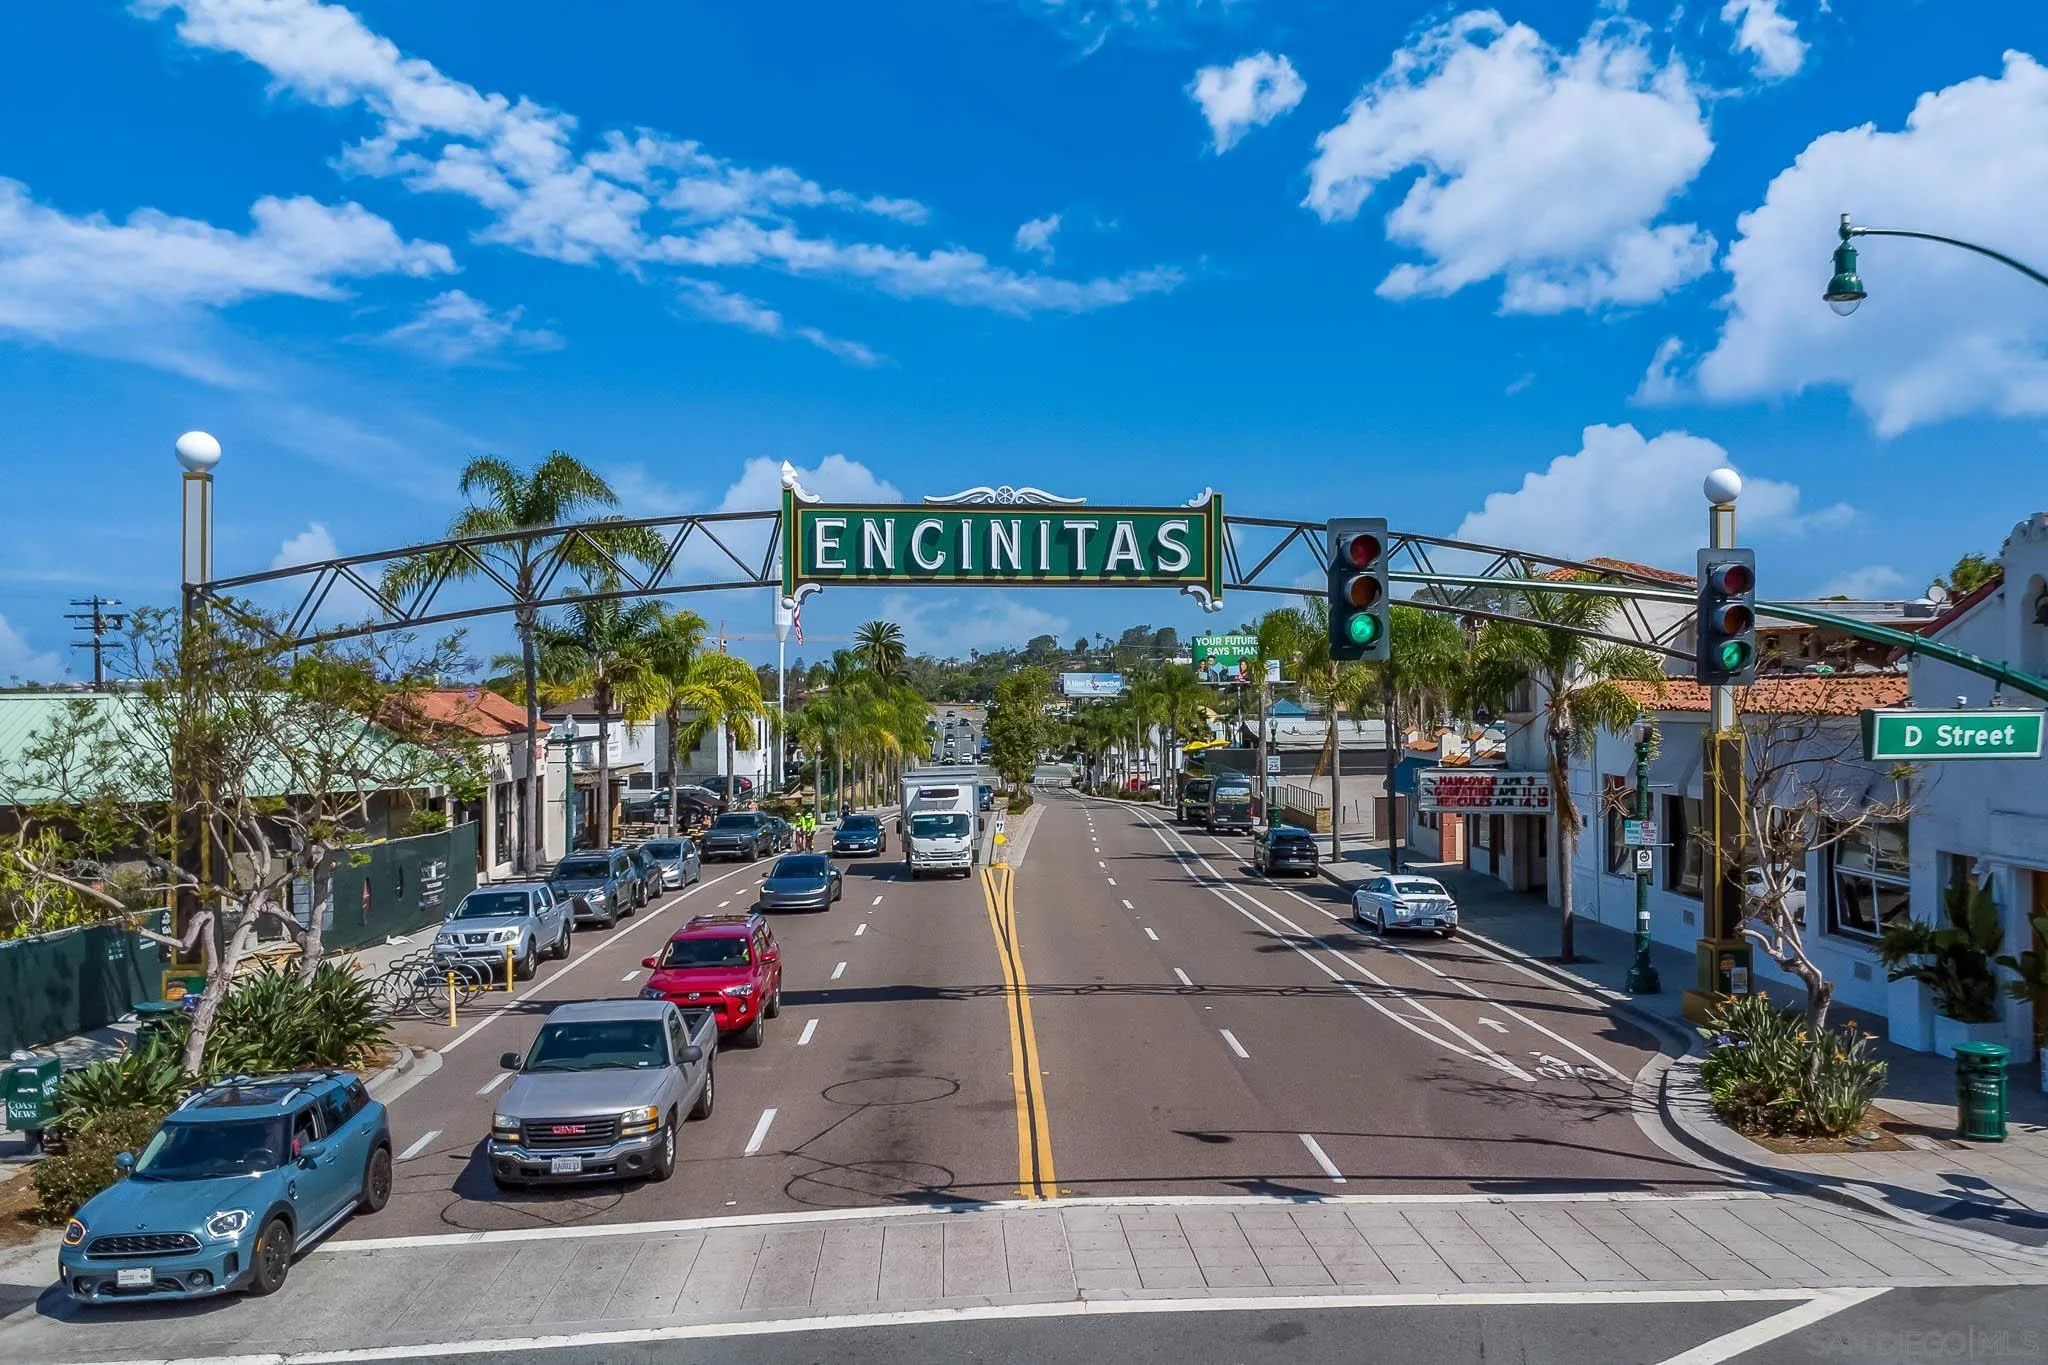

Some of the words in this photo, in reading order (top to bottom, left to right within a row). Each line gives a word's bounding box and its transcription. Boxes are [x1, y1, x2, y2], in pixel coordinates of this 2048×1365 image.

[815, 517, 1192, 572] ENCINITAS
[1195, 637, 1222, 646] YOUR
[1225, 636, 1259, 645] FUTURE
[1207, 647, 1230, 655] SAYS
[1232, 646, 1259, 655] THAN
[1905, 725, 1923, 747] D
[1935, 724, 2016, 747] Street
[1439, 776, 1498, 786] HANGOVER
[1502, 776, 1522, 785] APR
[1527, 776, 1535, 786] 9
[1499, 787, 1517, 796] APR
[1495, 797, 1514, 806] APR
[8, 1101, 37, 1110] COAST
[9, 1109, 37, 1119] NEWS
[552, 1124, 586, 1134] GMC
